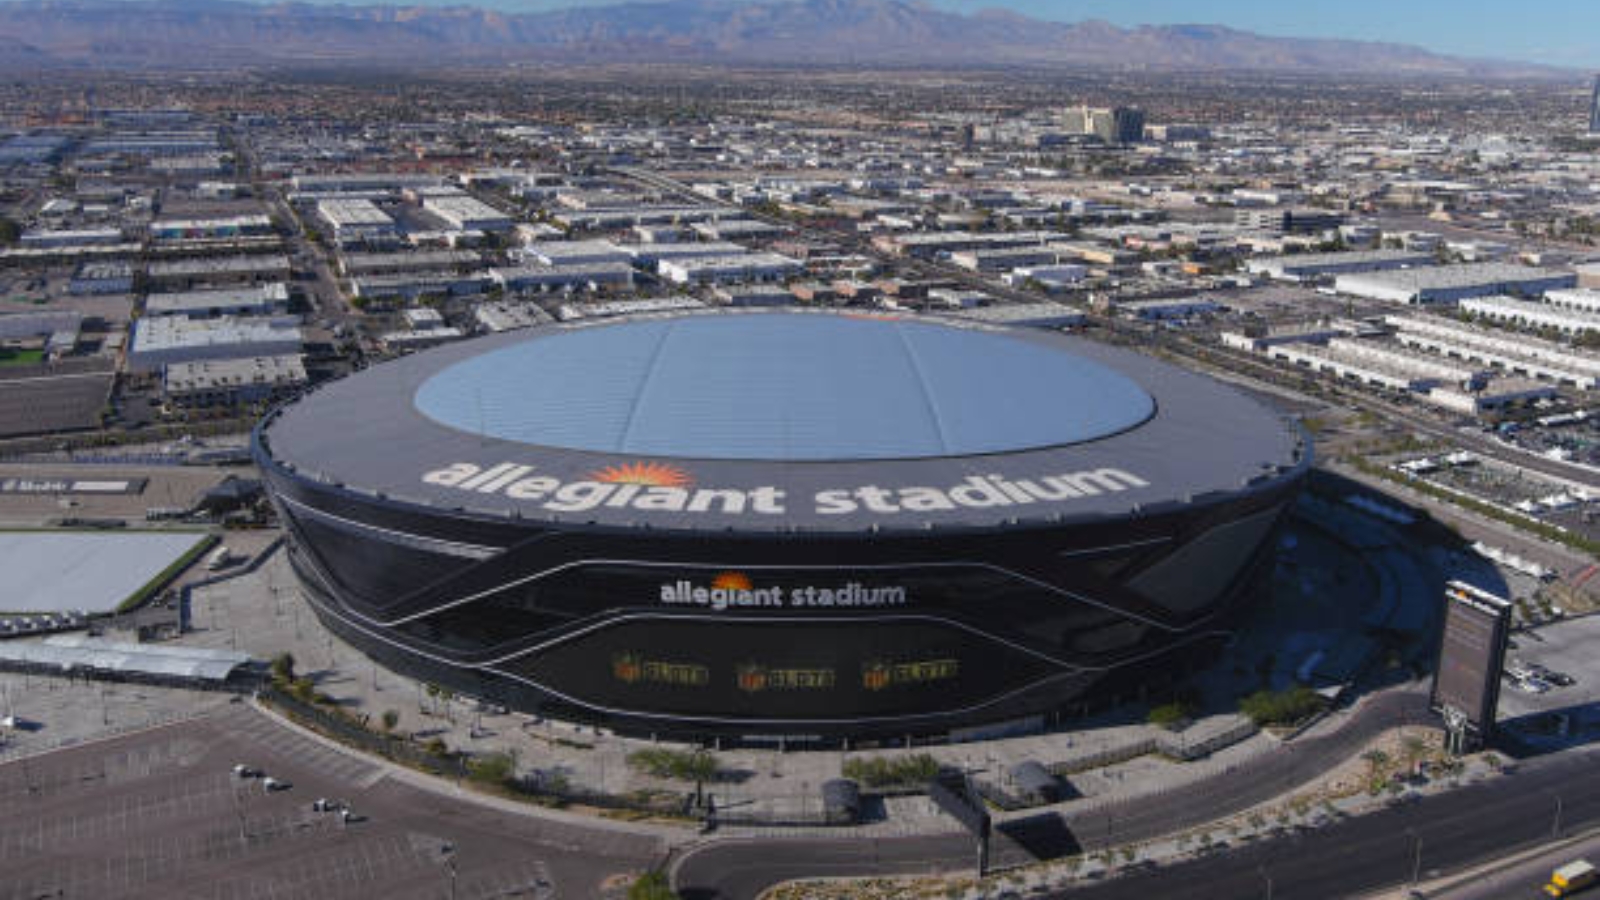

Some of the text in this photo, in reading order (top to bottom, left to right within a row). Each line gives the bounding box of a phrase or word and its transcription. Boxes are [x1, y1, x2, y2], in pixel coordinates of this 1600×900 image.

[421, 462, 1151, 515] allegiant stadium
[660, 580, 907, 611] allegiant stadium
